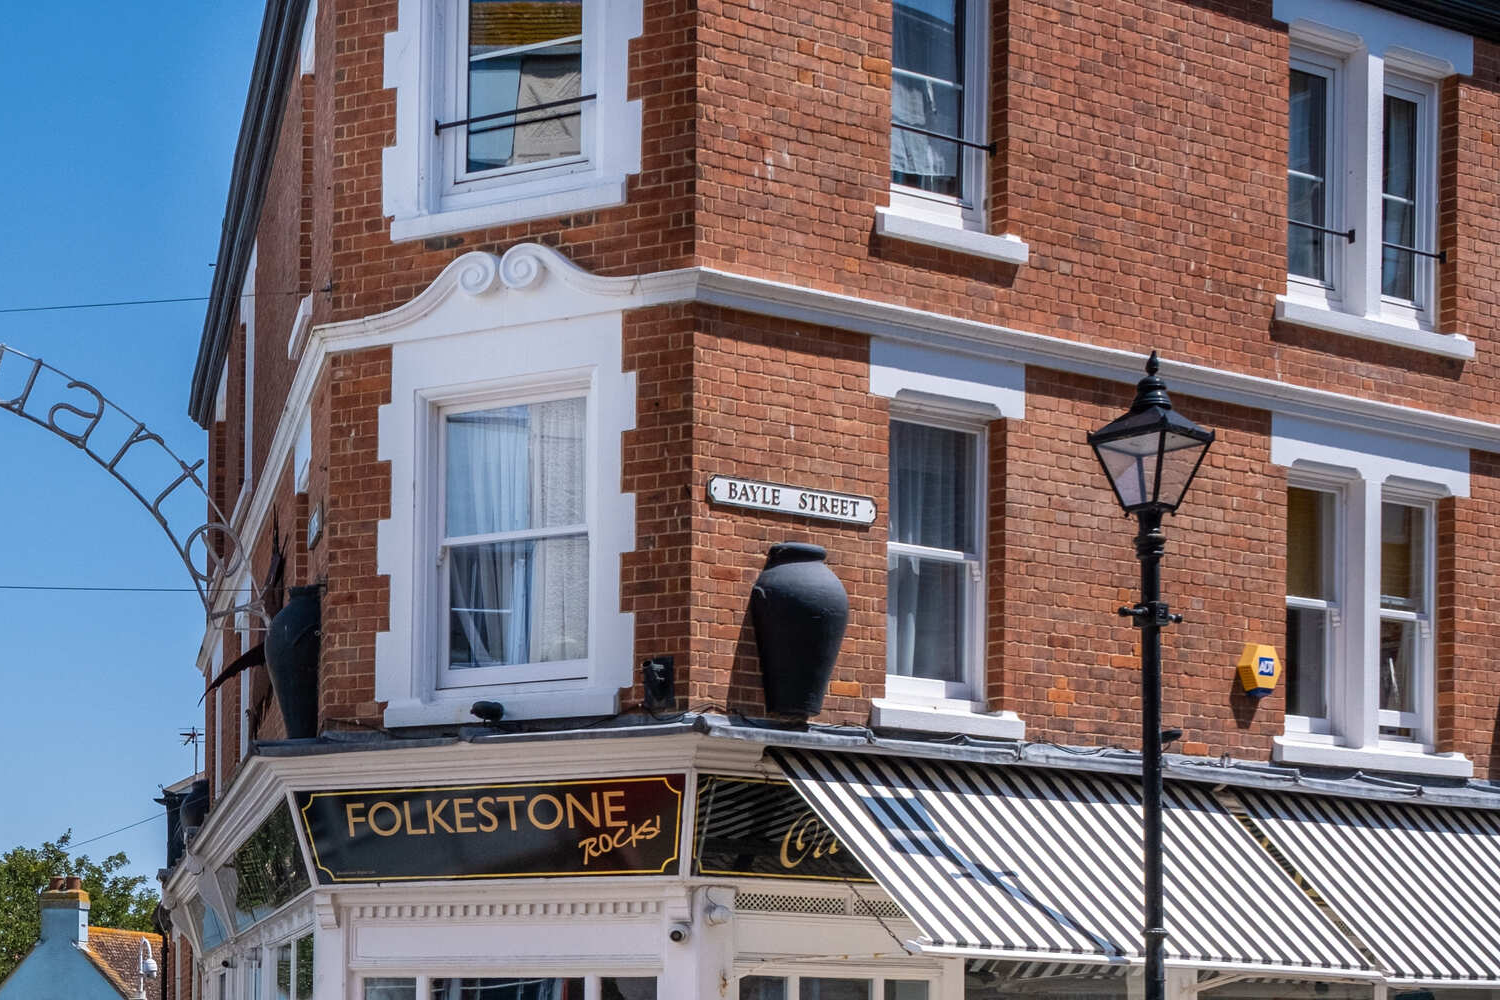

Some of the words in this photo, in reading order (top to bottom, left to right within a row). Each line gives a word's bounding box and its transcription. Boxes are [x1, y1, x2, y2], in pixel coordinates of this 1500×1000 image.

[728, 481, 781, 506] BAYLE
[798, 492, 860, 518] STREET
[346, 789, 629, 838] FOLKESTONE
[577, 815, 661, 866] ROCKS!
